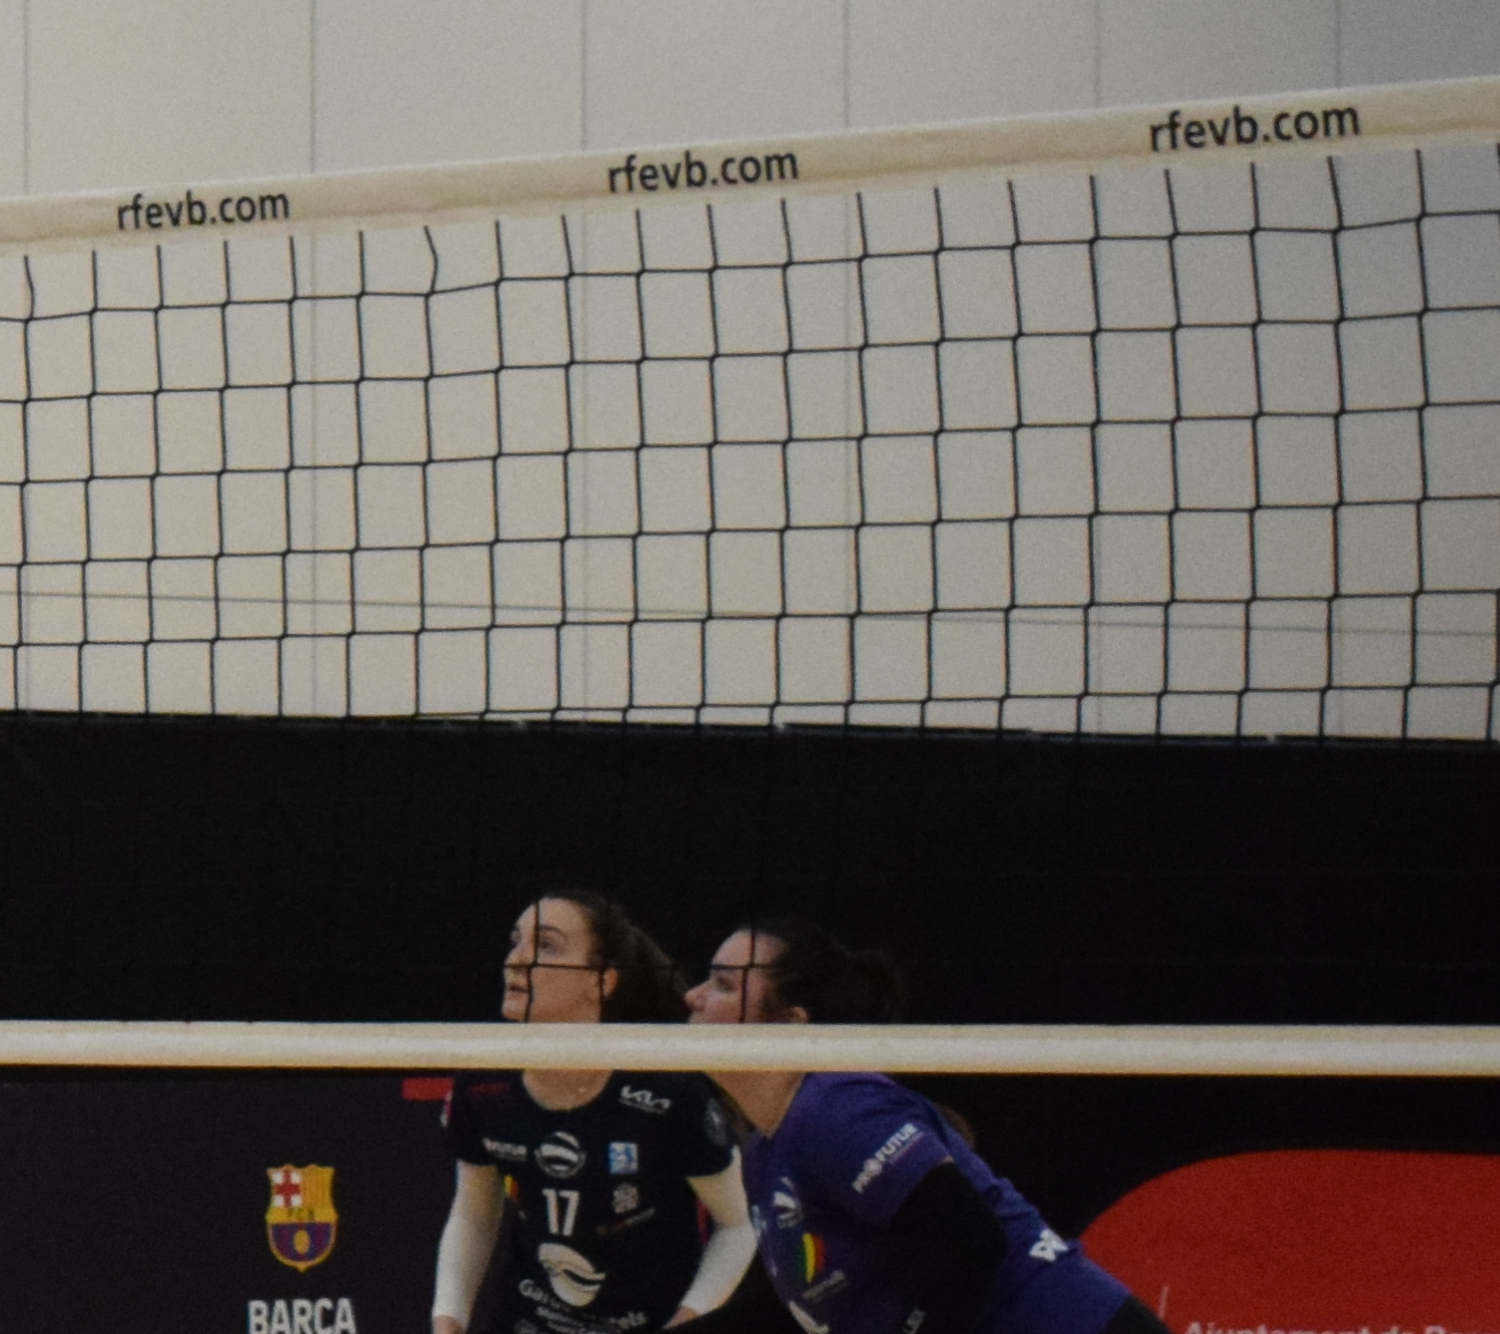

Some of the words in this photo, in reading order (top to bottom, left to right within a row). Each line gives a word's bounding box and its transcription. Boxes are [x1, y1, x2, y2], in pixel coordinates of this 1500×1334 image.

[1150, 104, 1361, 152] rfevb.com
[607, 148, 799, 194] rfevb.com
[116, 189, 290, 231] rfevb.com
[541, 1188, 580, 1237] 17
